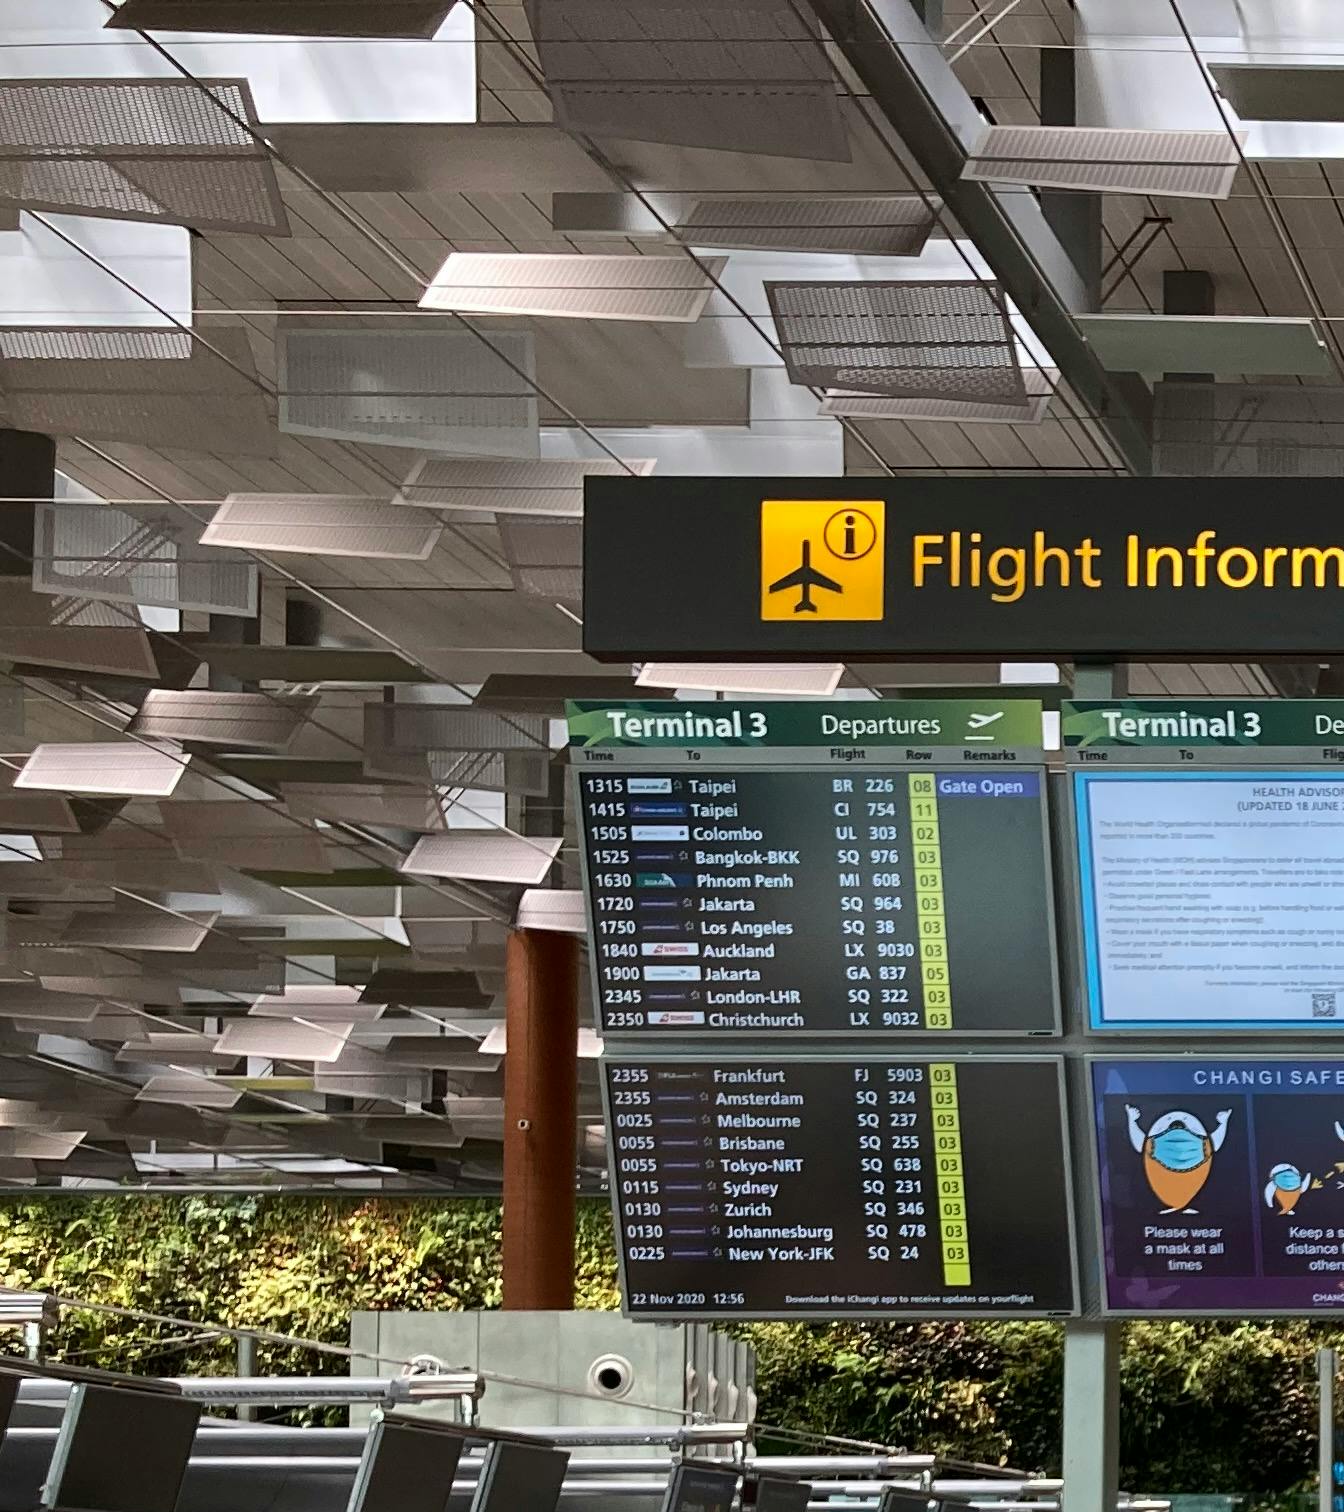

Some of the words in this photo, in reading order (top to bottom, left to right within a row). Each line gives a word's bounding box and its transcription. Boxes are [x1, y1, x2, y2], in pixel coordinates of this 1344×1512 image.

[915, 531, 1101, 602] Flight
[606, 711, 742, 737] Terminal
[750, 713, 767, 737] 3
[822, 715, 940, 739] Departures
[1101, 711, 1235, 737] Terminal
[1244, 713, 1261, 737] 3
[584, 751, 613, 760] Time
[687, 750, 700, 760] To
[830, 748, 865, 761] Flight
[906, 750, 932, 760] Row
[964, 750, 1016, 760] Remarks
[1078, 751, 1107, 760] Time
[1179, 750, 1193, 759] To
[587, 779, 622, 792] 1315
[689, 780, 736, 796] Taipei
[833, 779, 853, 792] BR
[866, 779, 893, 792] 226
[914, 780, 931, 792] 08
[940, 780, 976, 793] Gate
[981, 780, 1023, 796] Open
[1253, 788, 1294, 796] HEALTH
[590, 803, 625, 816] 1415
[690, 803, 737, 820] Taipei
[835, 803, 849, 816] CI
[868, 803, 895, 816] 754
[916, 804, 931, 816] 11
[1238, 802, 1292, 812] (UPDATED
[1296, 802, 1309, 810] 18
[1312, 802, 1338, 811] JUNE
[592, 827, 626, 840] 1505
[693, 827, 762, 840] Colombo
[836, 827, 857, 840] UL
[870, 826, 896, 840] 303
[917, 828, 933, 840] 02
[594, 850, 629, 863] 1525
[696, 850, 800, 867] Bangkok-BKK
[838, 850, 859, 865] SQ
[871, 850, 898, 863] 976
[919, 851, 935, 863] 03
[596, 874, 631, 887] 1630
[697, 874, 751, 887] Phnom
[755, 874, 793, 887] Penh
[840, 874, 859, 886] MI
[873, 874, 900, 886] 608
[920, 875, 937, 887] 03
[603, 944, 637, 957] 1840
[703, 943, 774, 957] Auckland
[845, 944, 864, 956] LX
[878, 944, 914, 956] 9030
[925, 945, 942, 957] 03
[1194, 1071, 1281, 1084] CHANGI
[622, 1159, 656, 1171] 0055
[720, 1159, 803, 1175] Tokyo-NRT
[862, 1158, 882, 1172] SQ
[894, 1158, 921, 1171] 638
[941, 1159, 957, 1171] 03
[1145, 1226, 1188, 1238] Please
[1191, 1229, 1222, 1237] wear
[1145, 1245, 1153, 1254] a
[1157, 1243, 1190, 1254] mask
[1194, 1244, 1206, 1254] at
[1209, 1243, 1224, 1254] all
[1168, 1260, 1202, 1270] times
[633, 1294, 646, 1304] 22
[650, 1294, 673, 1304] Nov
[677, 1294, 705, 1304] 2020
[714, 1293, 744, 1304] 12:56
